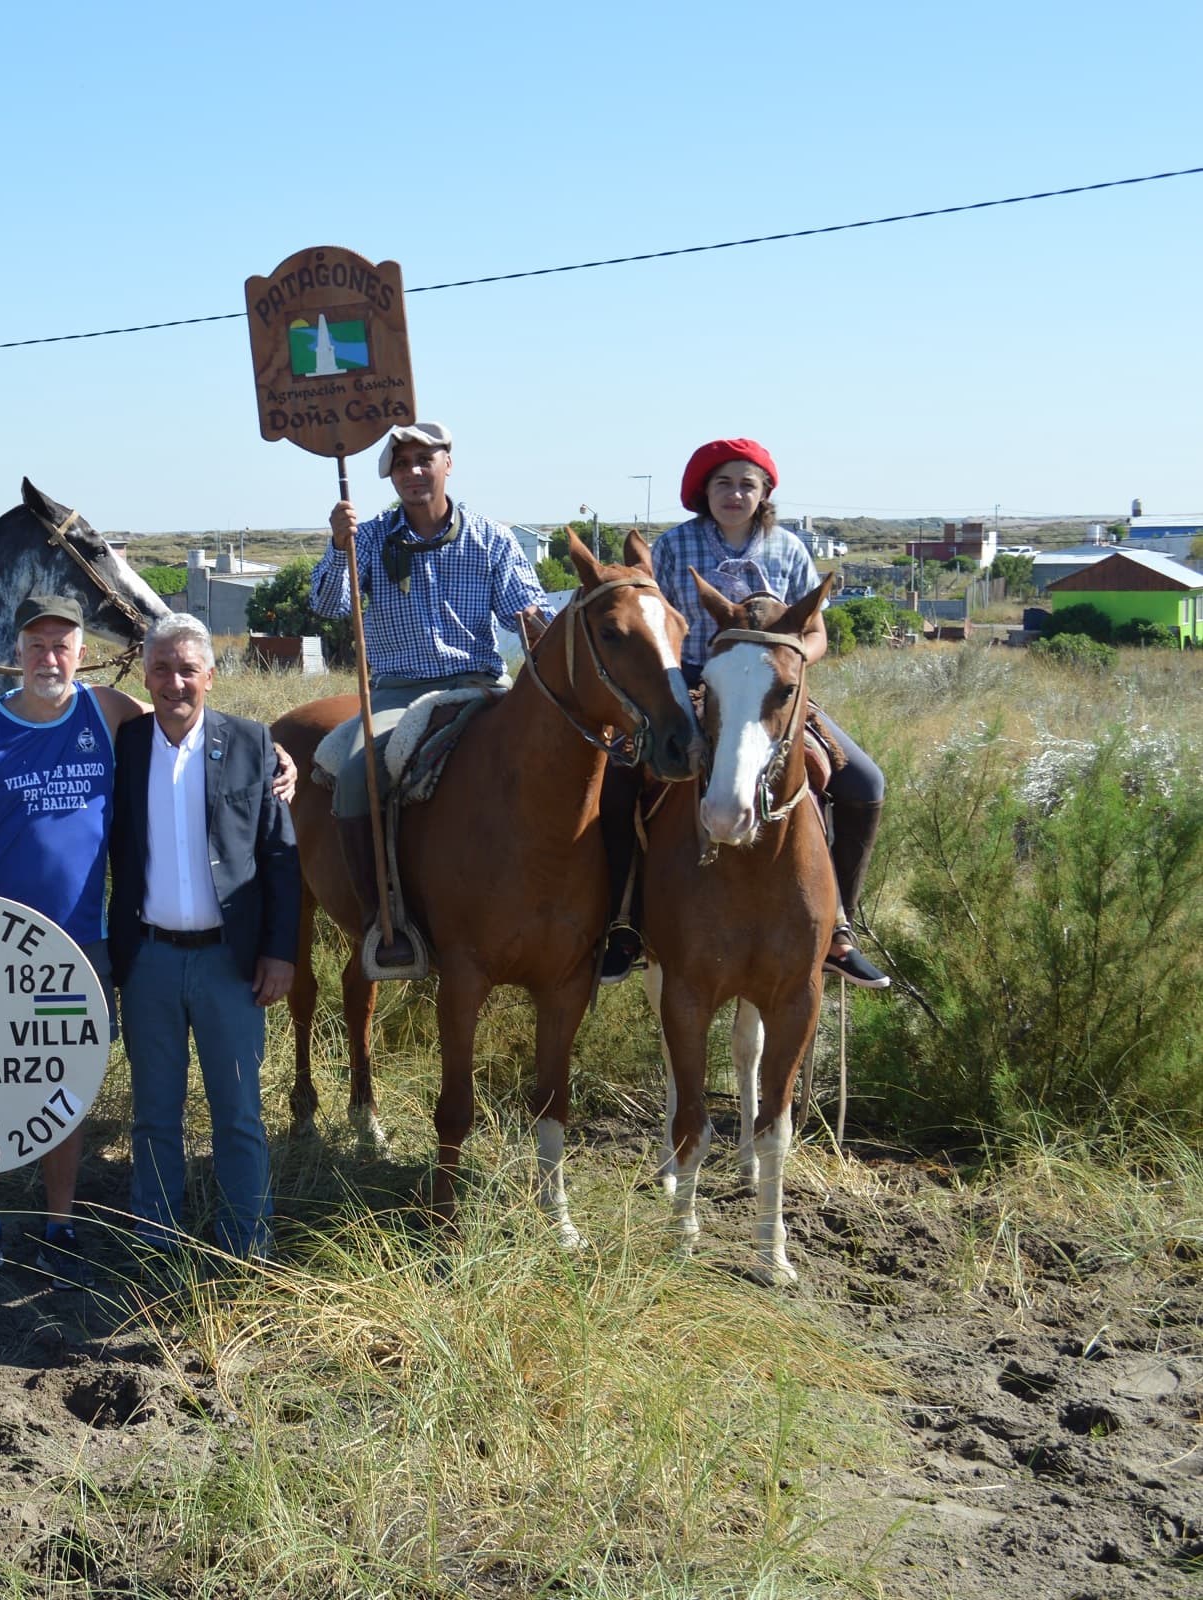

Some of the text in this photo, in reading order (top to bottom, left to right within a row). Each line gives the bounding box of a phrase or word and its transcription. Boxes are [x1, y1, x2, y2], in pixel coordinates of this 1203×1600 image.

[255, 264, 393, 327] PATAGONES
[266, 376, 404, 403] Agrupación Gaucha
[267, 400, 409, 431] Doña Cata
[4, 772, 41, 791] VILLA
[66, 763, 105, 778] MARZO
[42, 796, 88, 811] BALIZA
[4, 963, 76, 994] 1827
[10, 1019, 99, 1046] VILLA
[8, 1088, 76, 1157] 2017
